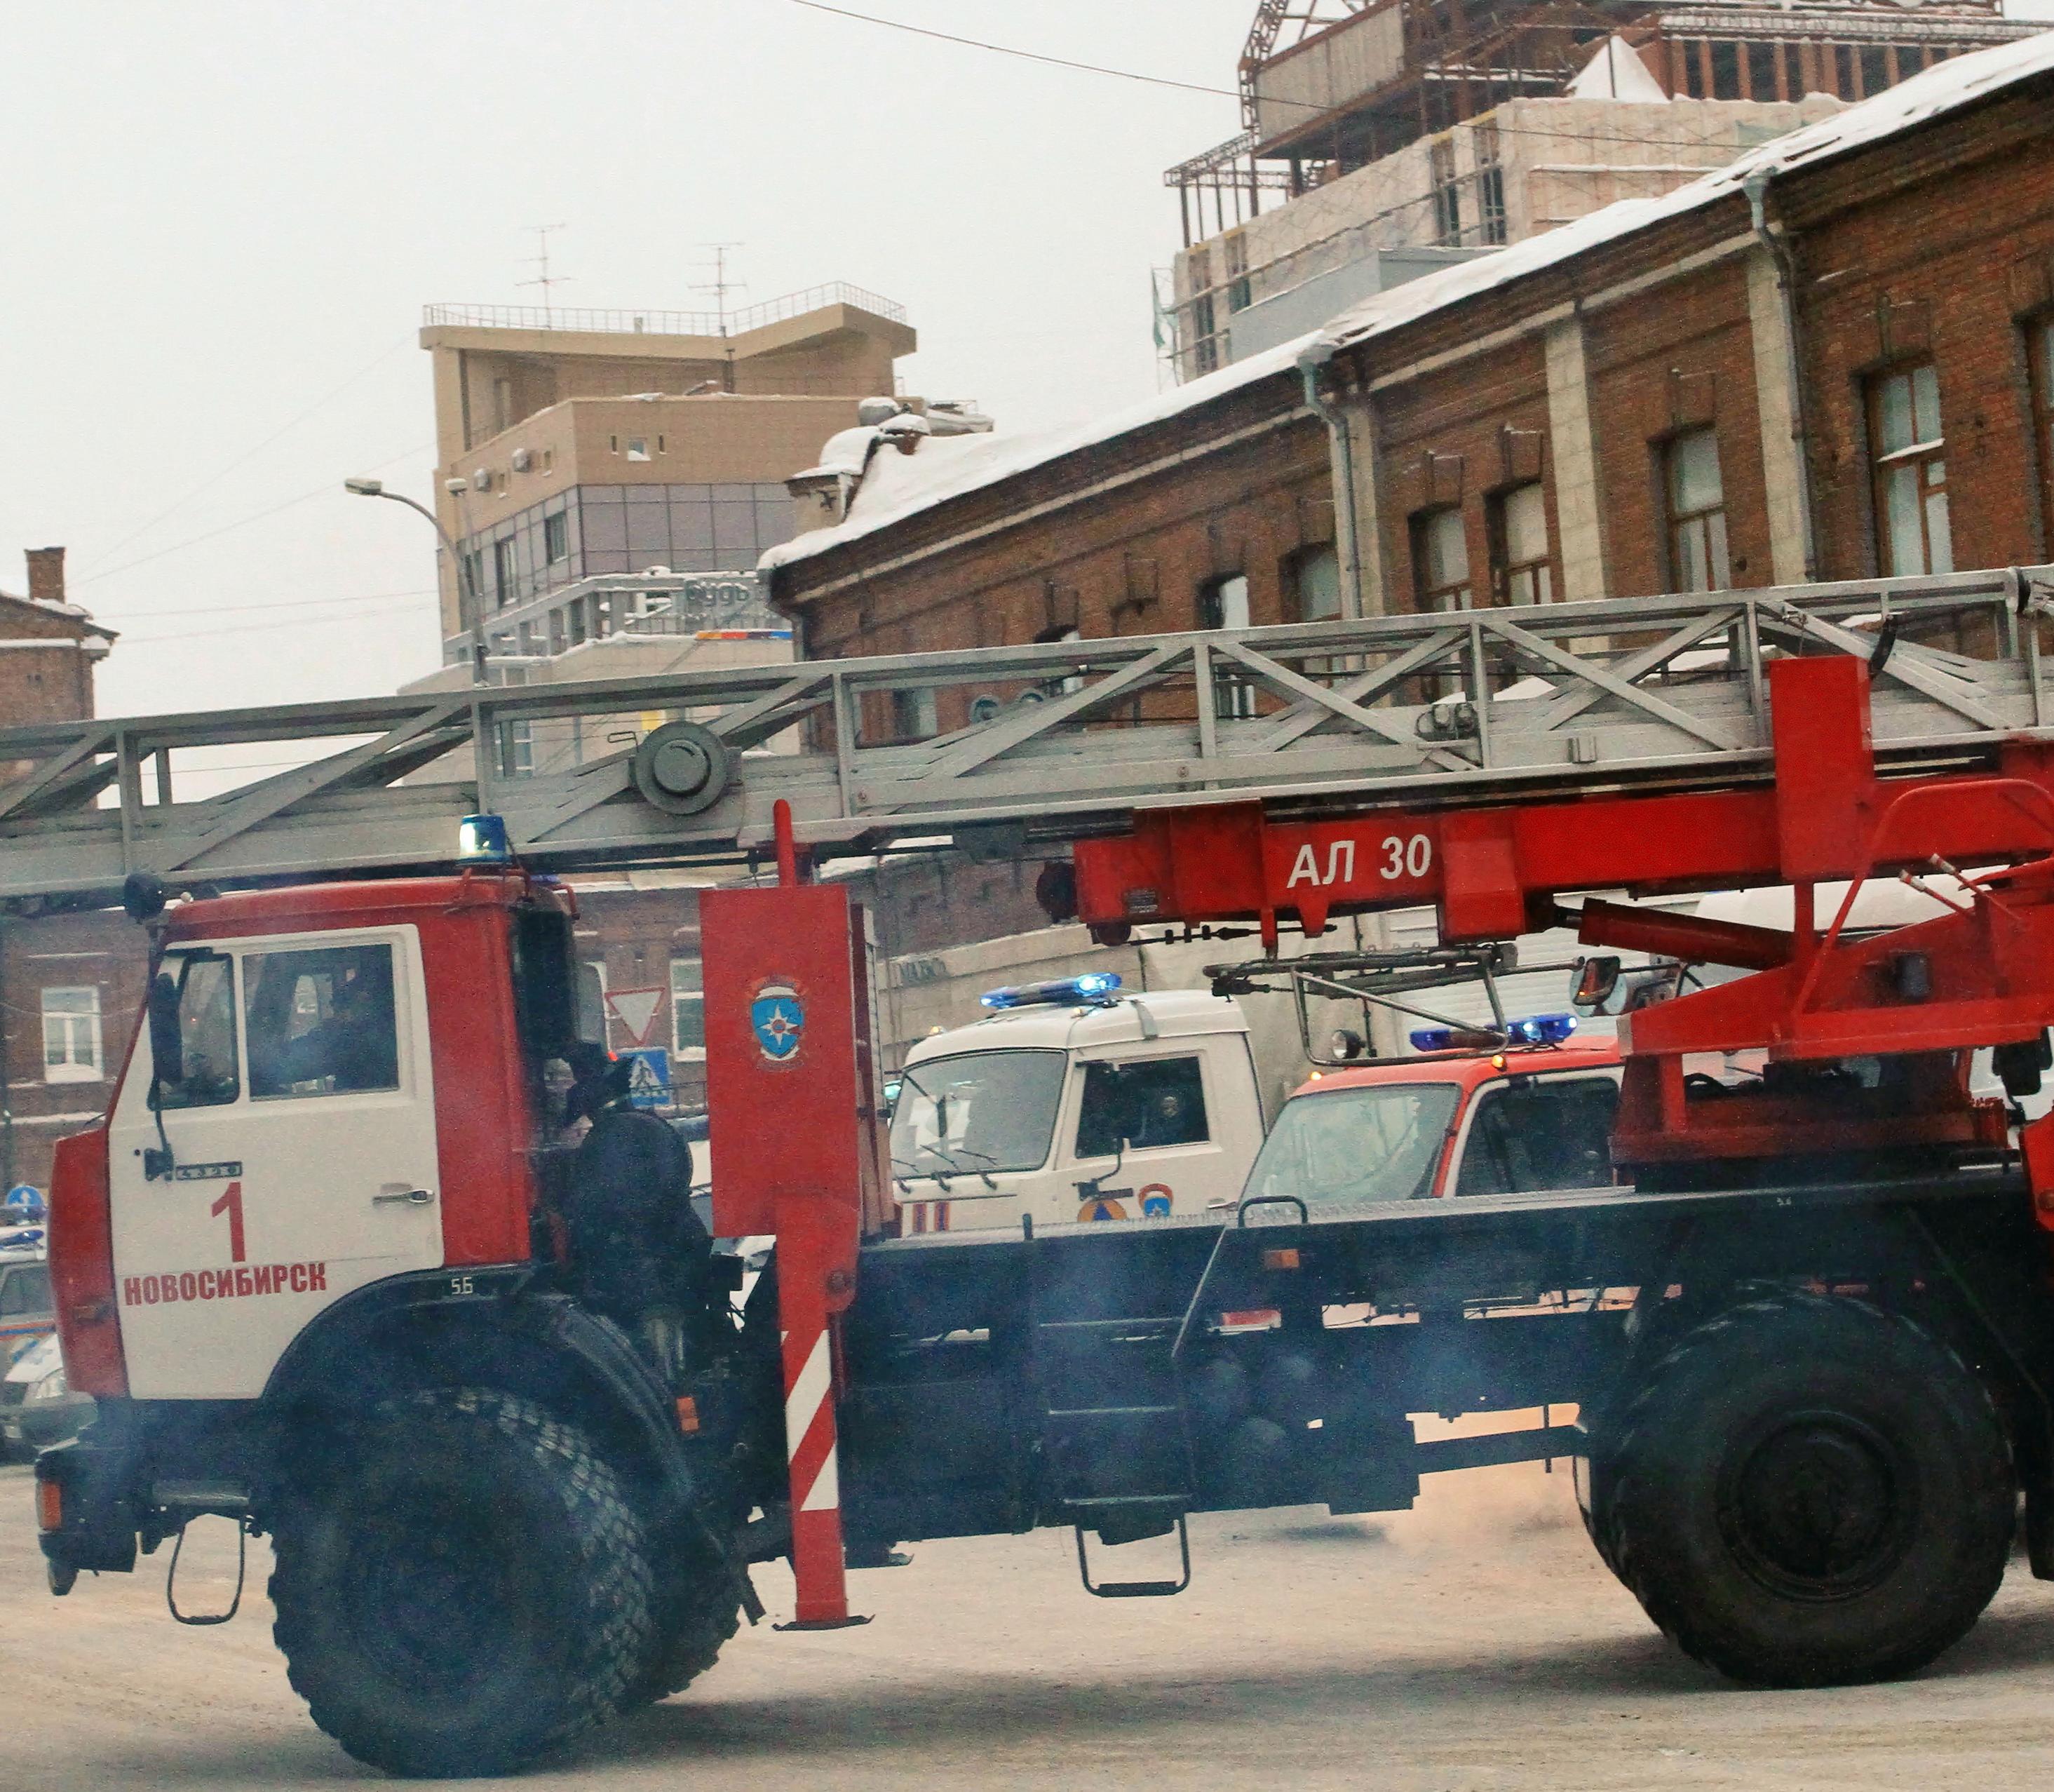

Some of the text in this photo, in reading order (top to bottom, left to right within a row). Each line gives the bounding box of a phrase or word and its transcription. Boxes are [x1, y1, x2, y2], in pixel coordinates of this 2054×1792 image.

[1286, 833, 1432, 889] АЛ 30
[212, 1182, 245, 1262] 1
[123, 1262, 327, 1306] НОВОСИБИРСК
